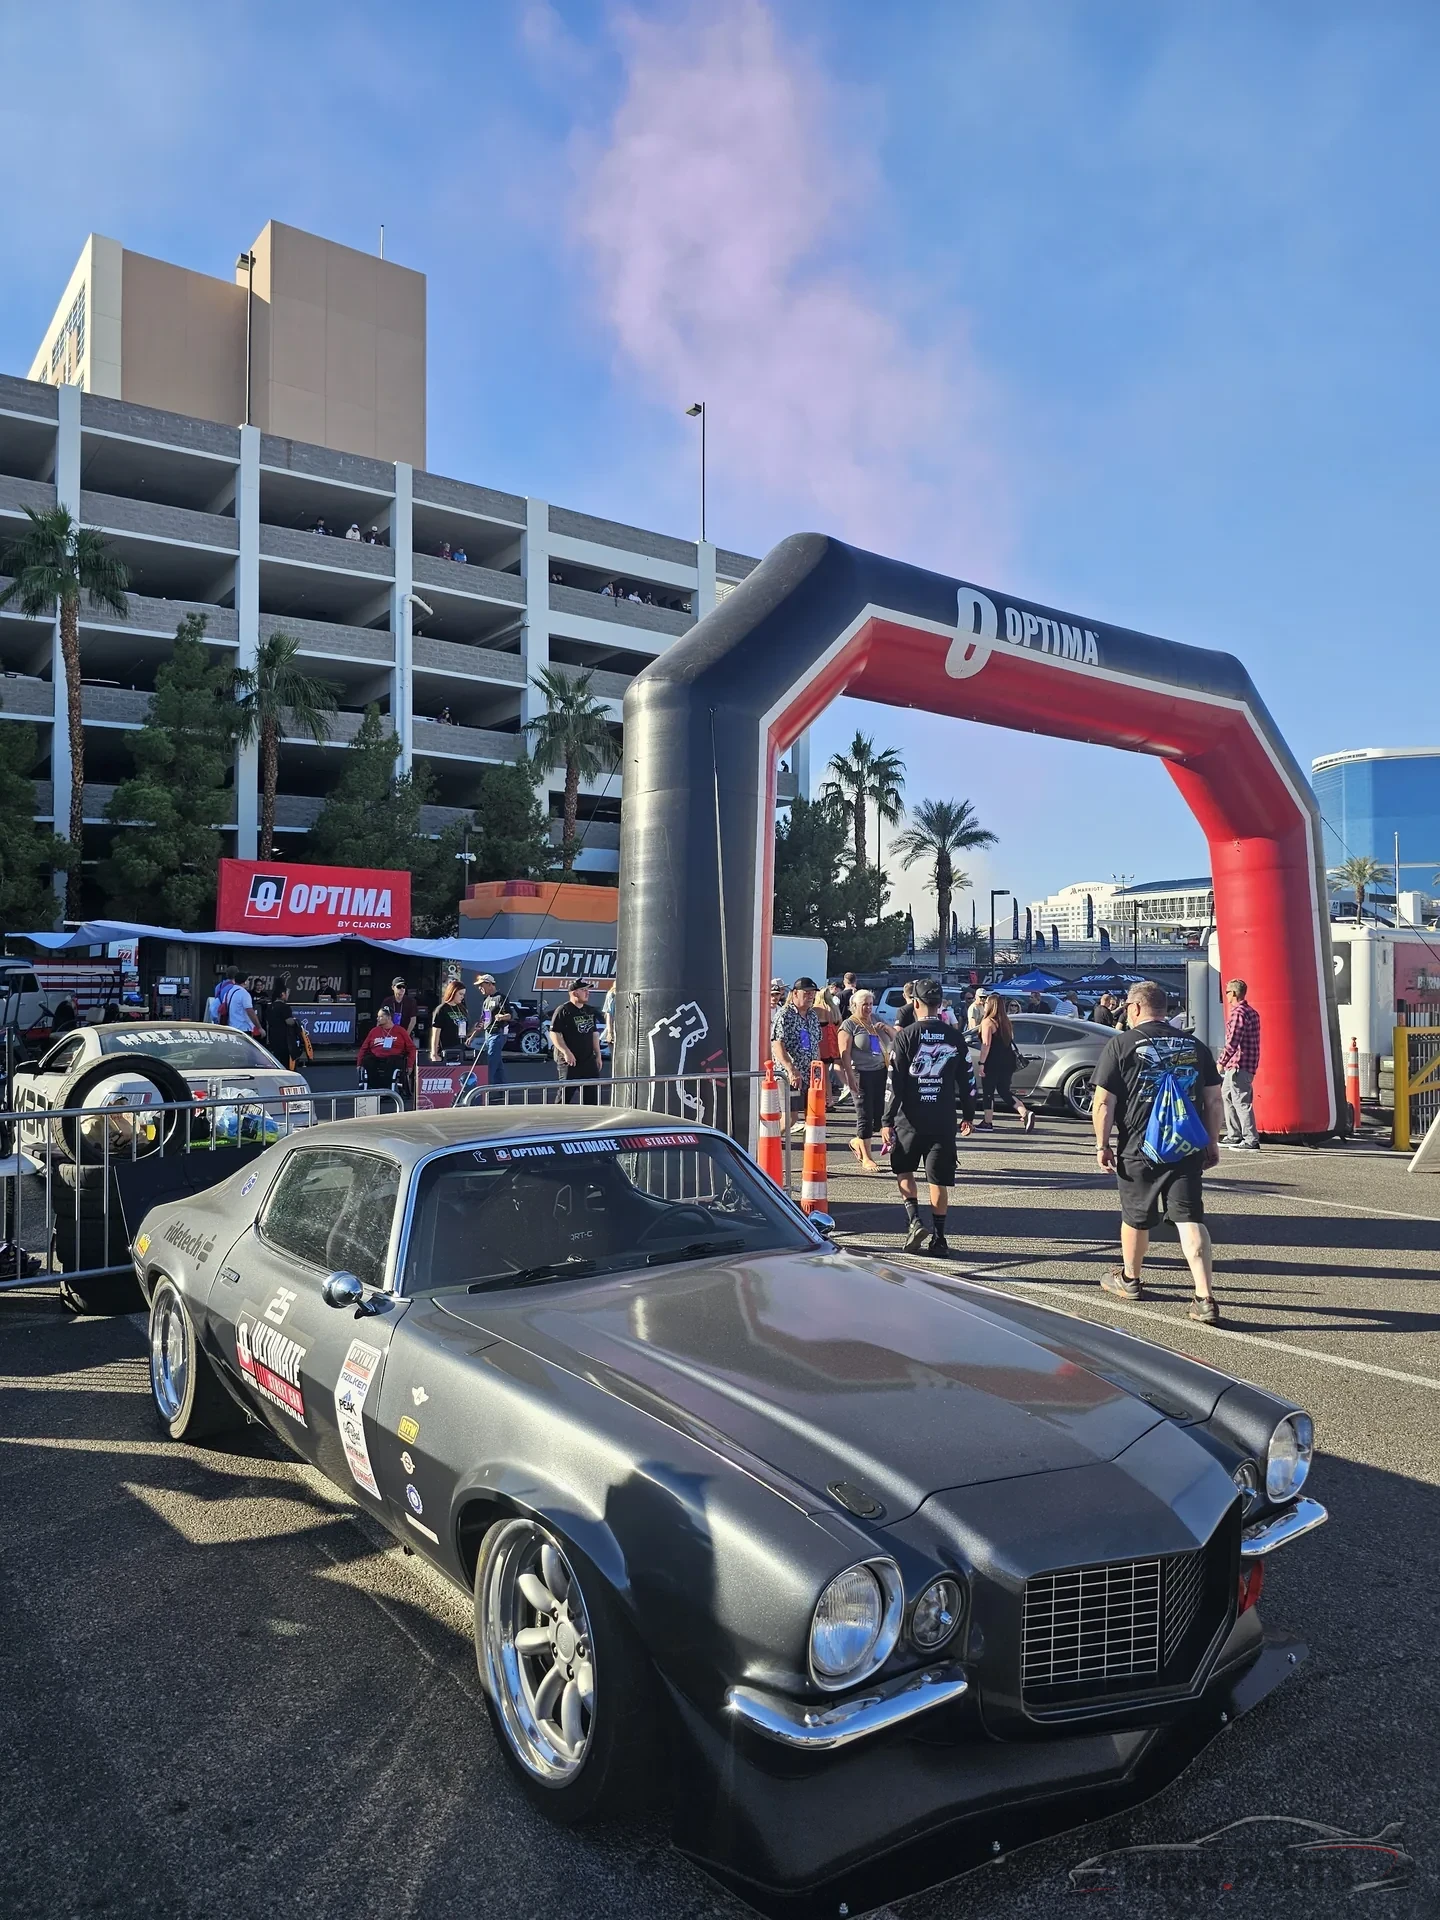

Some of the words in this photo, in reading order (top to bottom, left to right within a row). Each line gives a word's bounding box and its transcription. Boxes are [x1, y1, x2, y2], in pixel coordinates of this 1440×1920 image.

[1005, 606, 1099, 666] OPTIMA
[288, 883, 392, 918] OPTIMA
[1078, 885, 1104, 894] MARRIOTT
[337, 920, 350, 928] BY
[352, 920, 392, 930] CLARIOS
[116, 1030, 173, 1047] HOT
[313, 1020, 351, 1034] STATION
[511, 1145, 555, 1159] OPTIMA
[561, 1139, 620, 1155] ULTIMATE
[645, 1136, 676, 1147] STREET
[678, 1134, 697, 1144] CAR
[163, 1220, 203, 1258] ridetech
[263, 1286, 298, 1325] 25
[250, 1320, 307, 1389] ULTIMATE
[349, 1346, 377, 1371] OPTIMA
[268, 1373, 289, 1401] STREET
[288, 1388, 302, 1409] CAR
[341, 1372, 368, 1392] FALKEN
[259, 1382, 308, 1428] INVITATIONAL
[338, 1398, 357, 1416] PEAK
